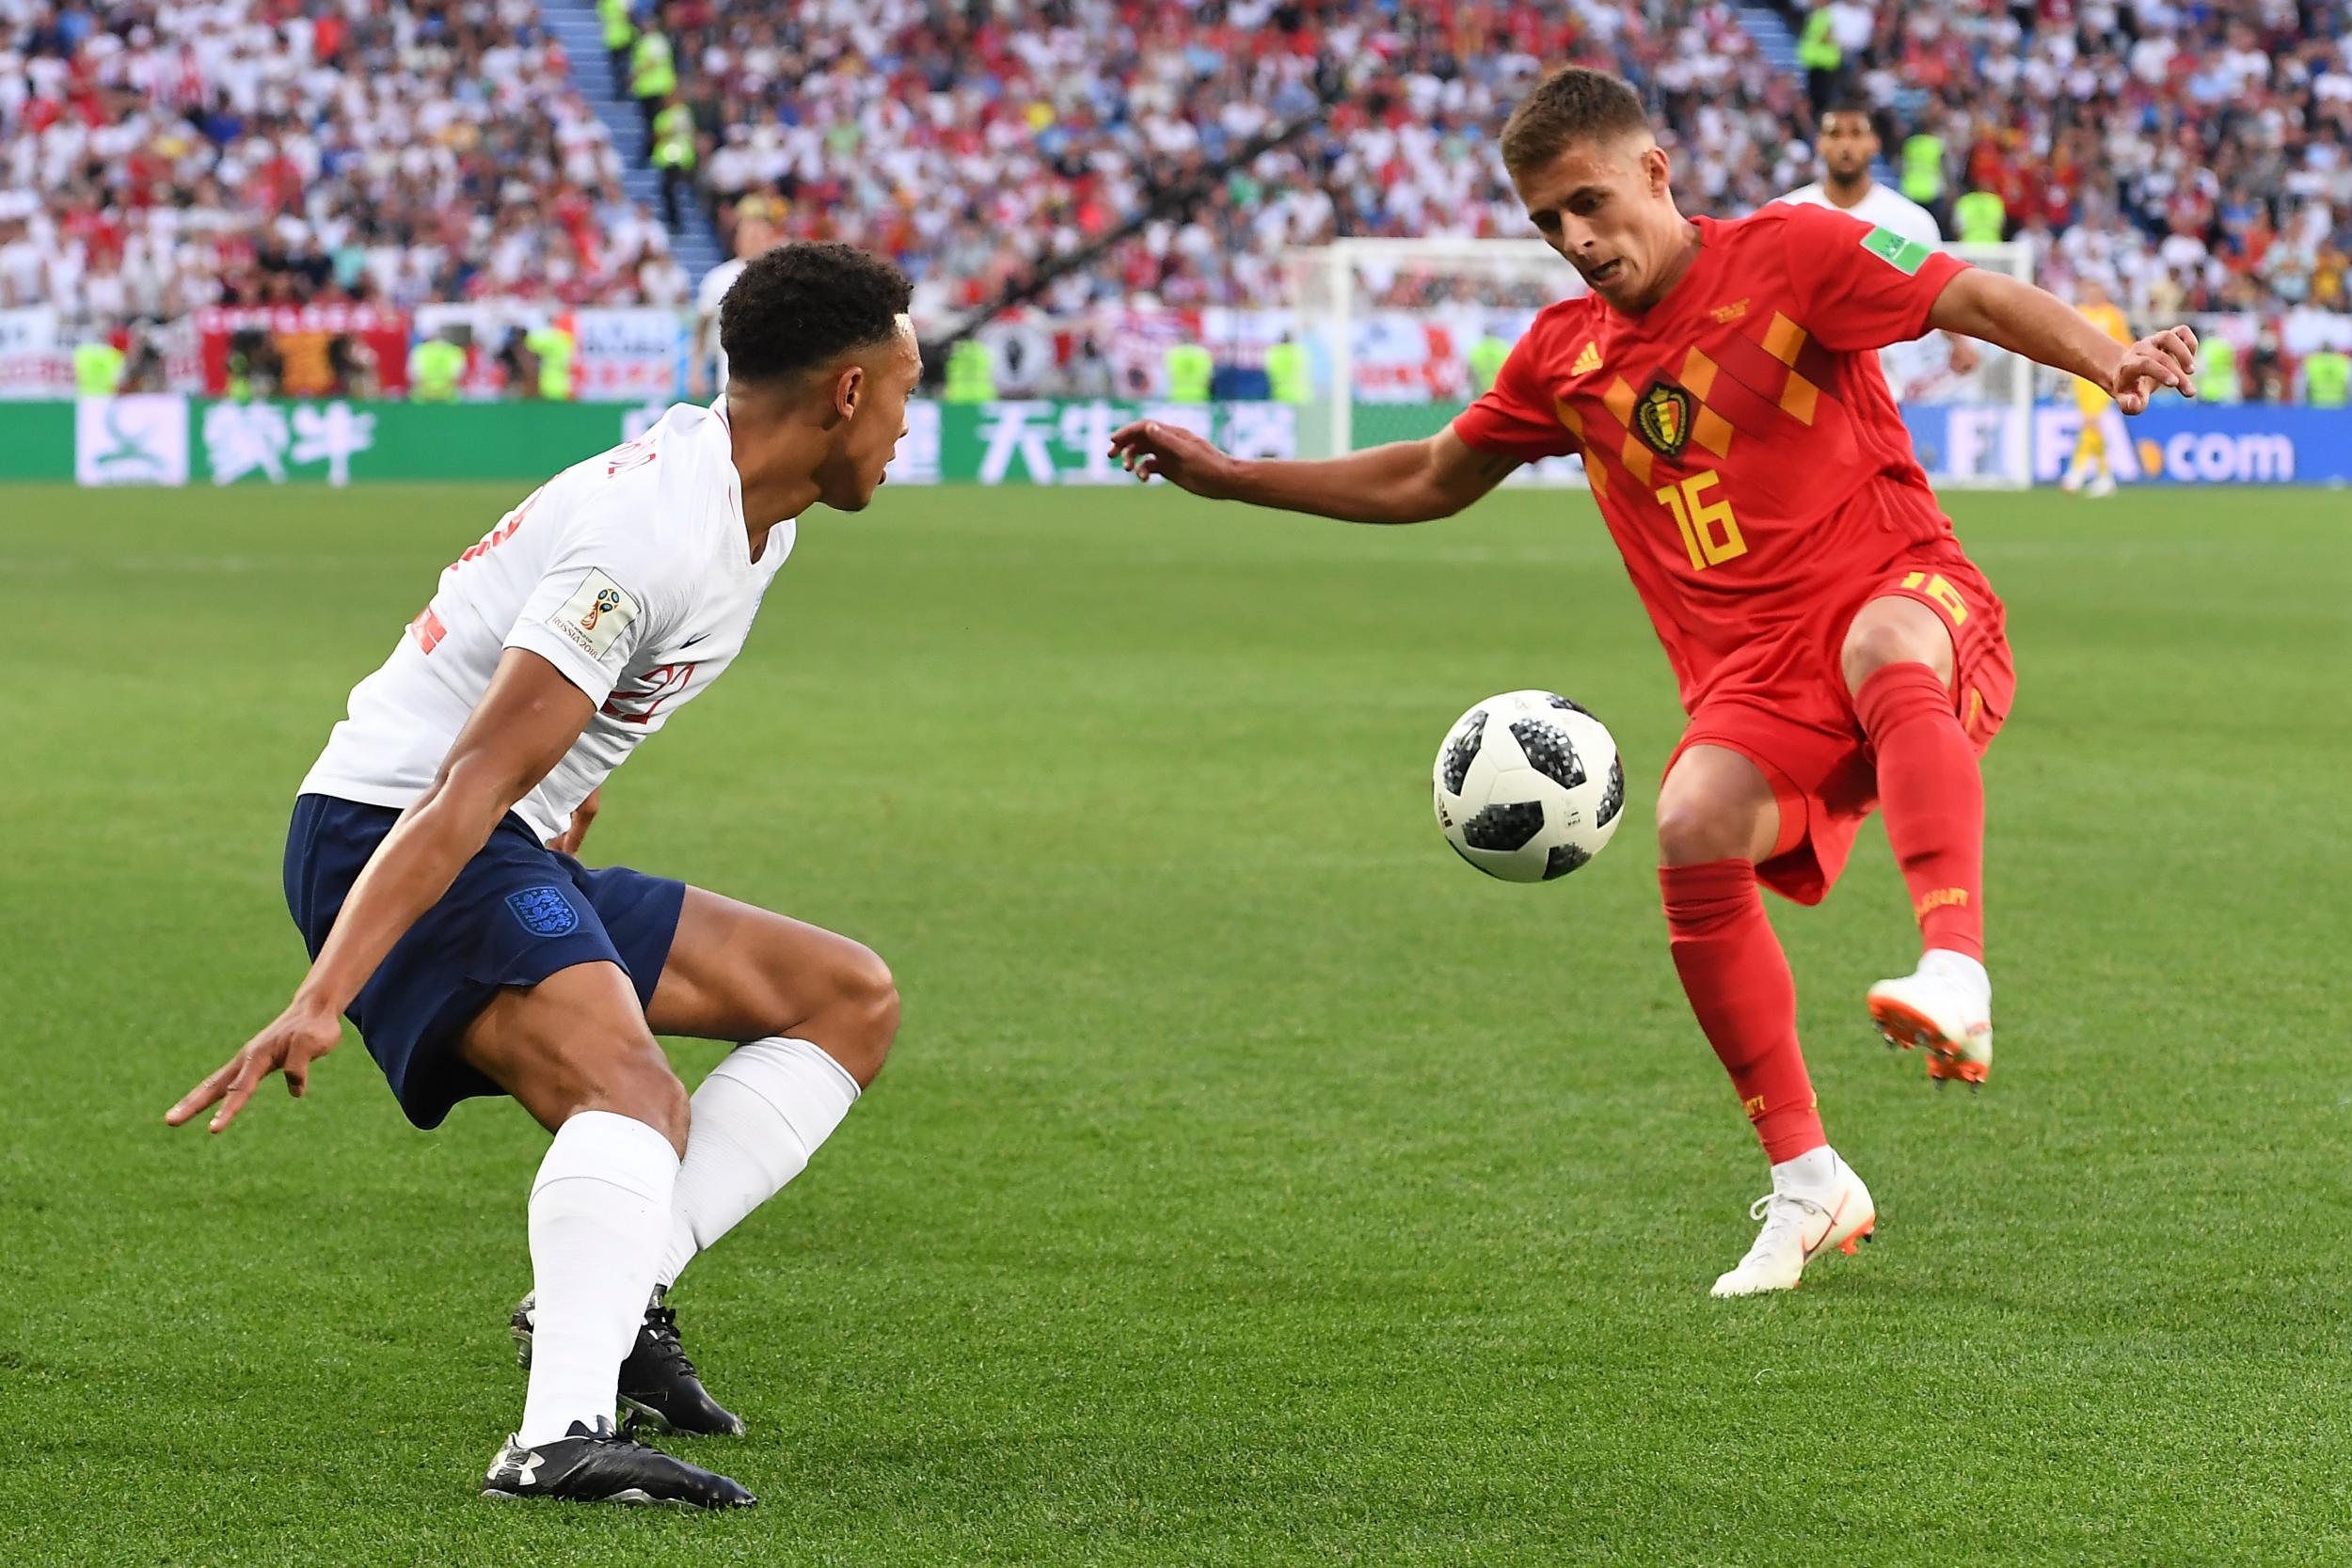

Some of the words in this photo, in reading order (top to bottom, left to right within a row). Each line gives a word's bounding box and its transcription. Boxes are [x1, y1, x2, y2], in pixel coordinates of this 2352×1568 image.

[1656, 469, 1748, 572] 16
[552, 616, 580, 644] RUSSIA
[579, 641, 598, 659] 2018
